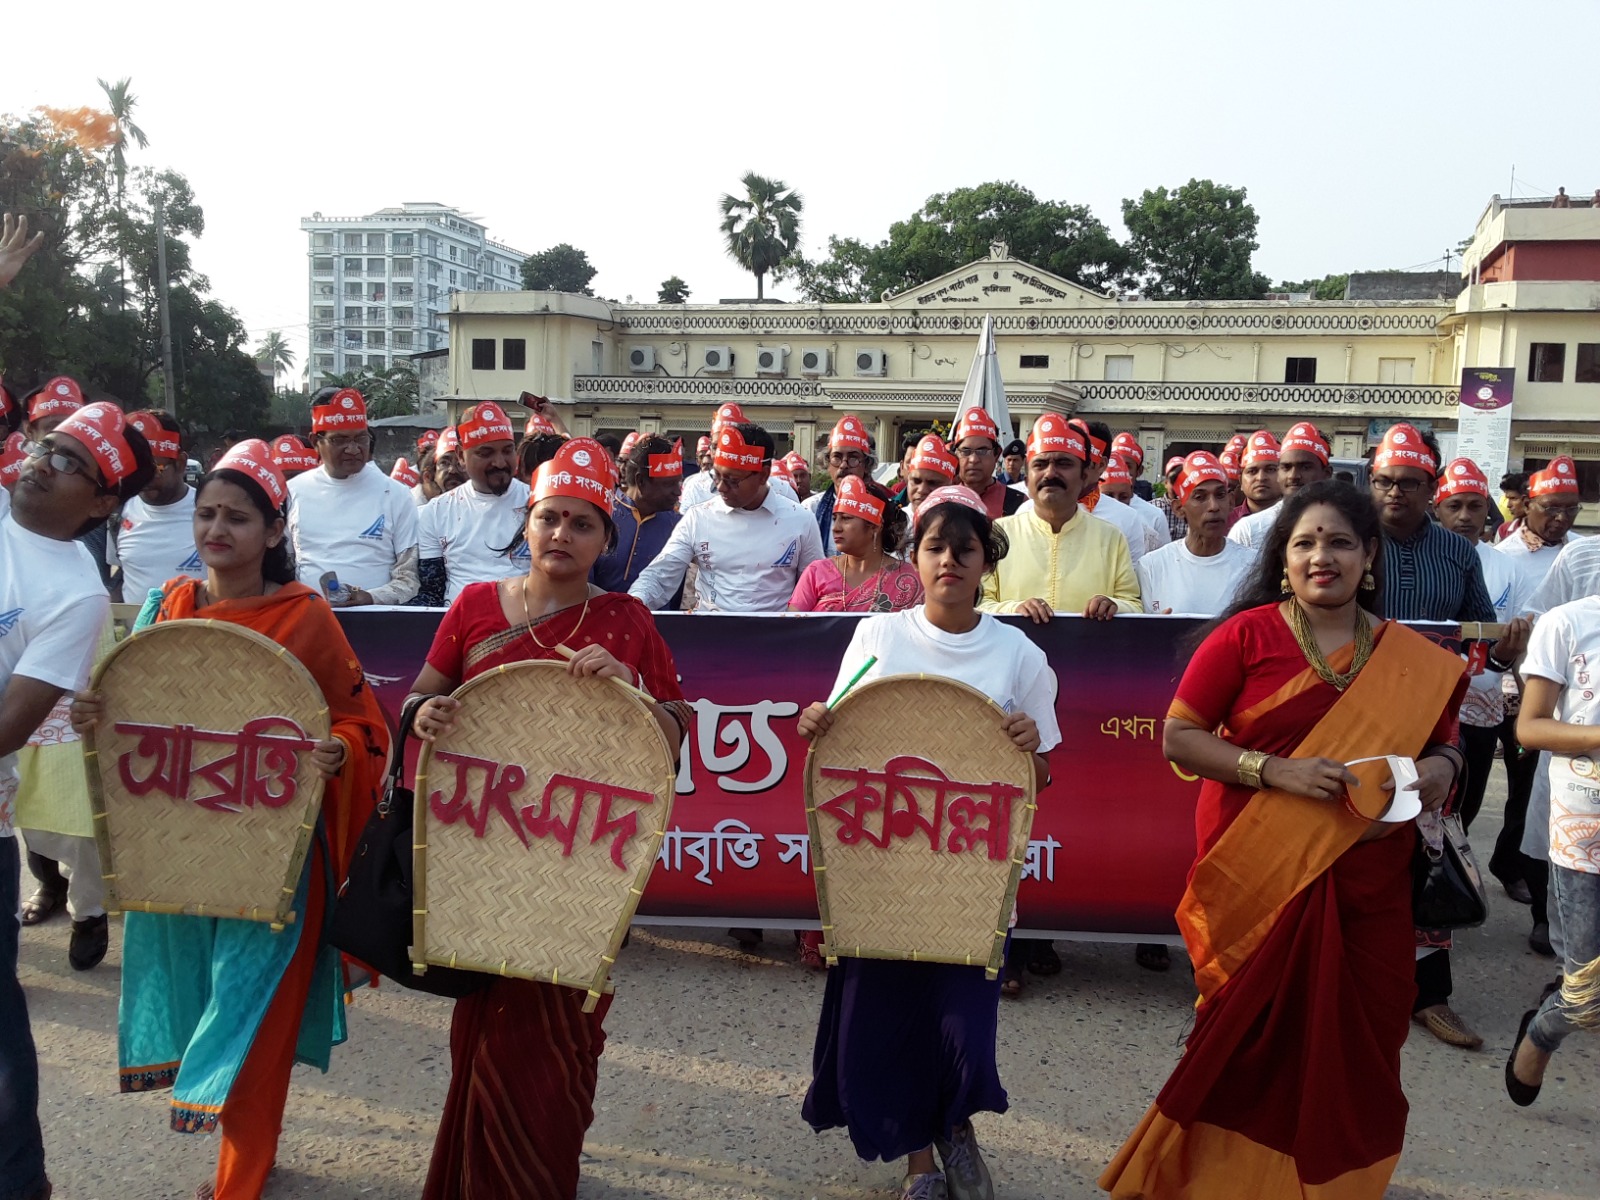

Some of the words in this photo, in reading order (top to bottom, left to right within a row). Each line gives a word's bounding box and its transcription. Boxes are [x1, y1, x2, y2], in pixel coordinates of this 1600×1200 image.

[73, 420, 102, 441] সংসদ
[96, 438, 124, 474] কুমিল্লা
[1394, 450, 1419, 460] সংসদ
[257, 465, 282, 498] কুমিল্লা
[575, 474, 604, 497] সংসদ
[1100, 715, 1157, 740] এখন
[430, 750, 655, 872] সংসদ
[816, 754, 1024, 861] কুমিল্লা
